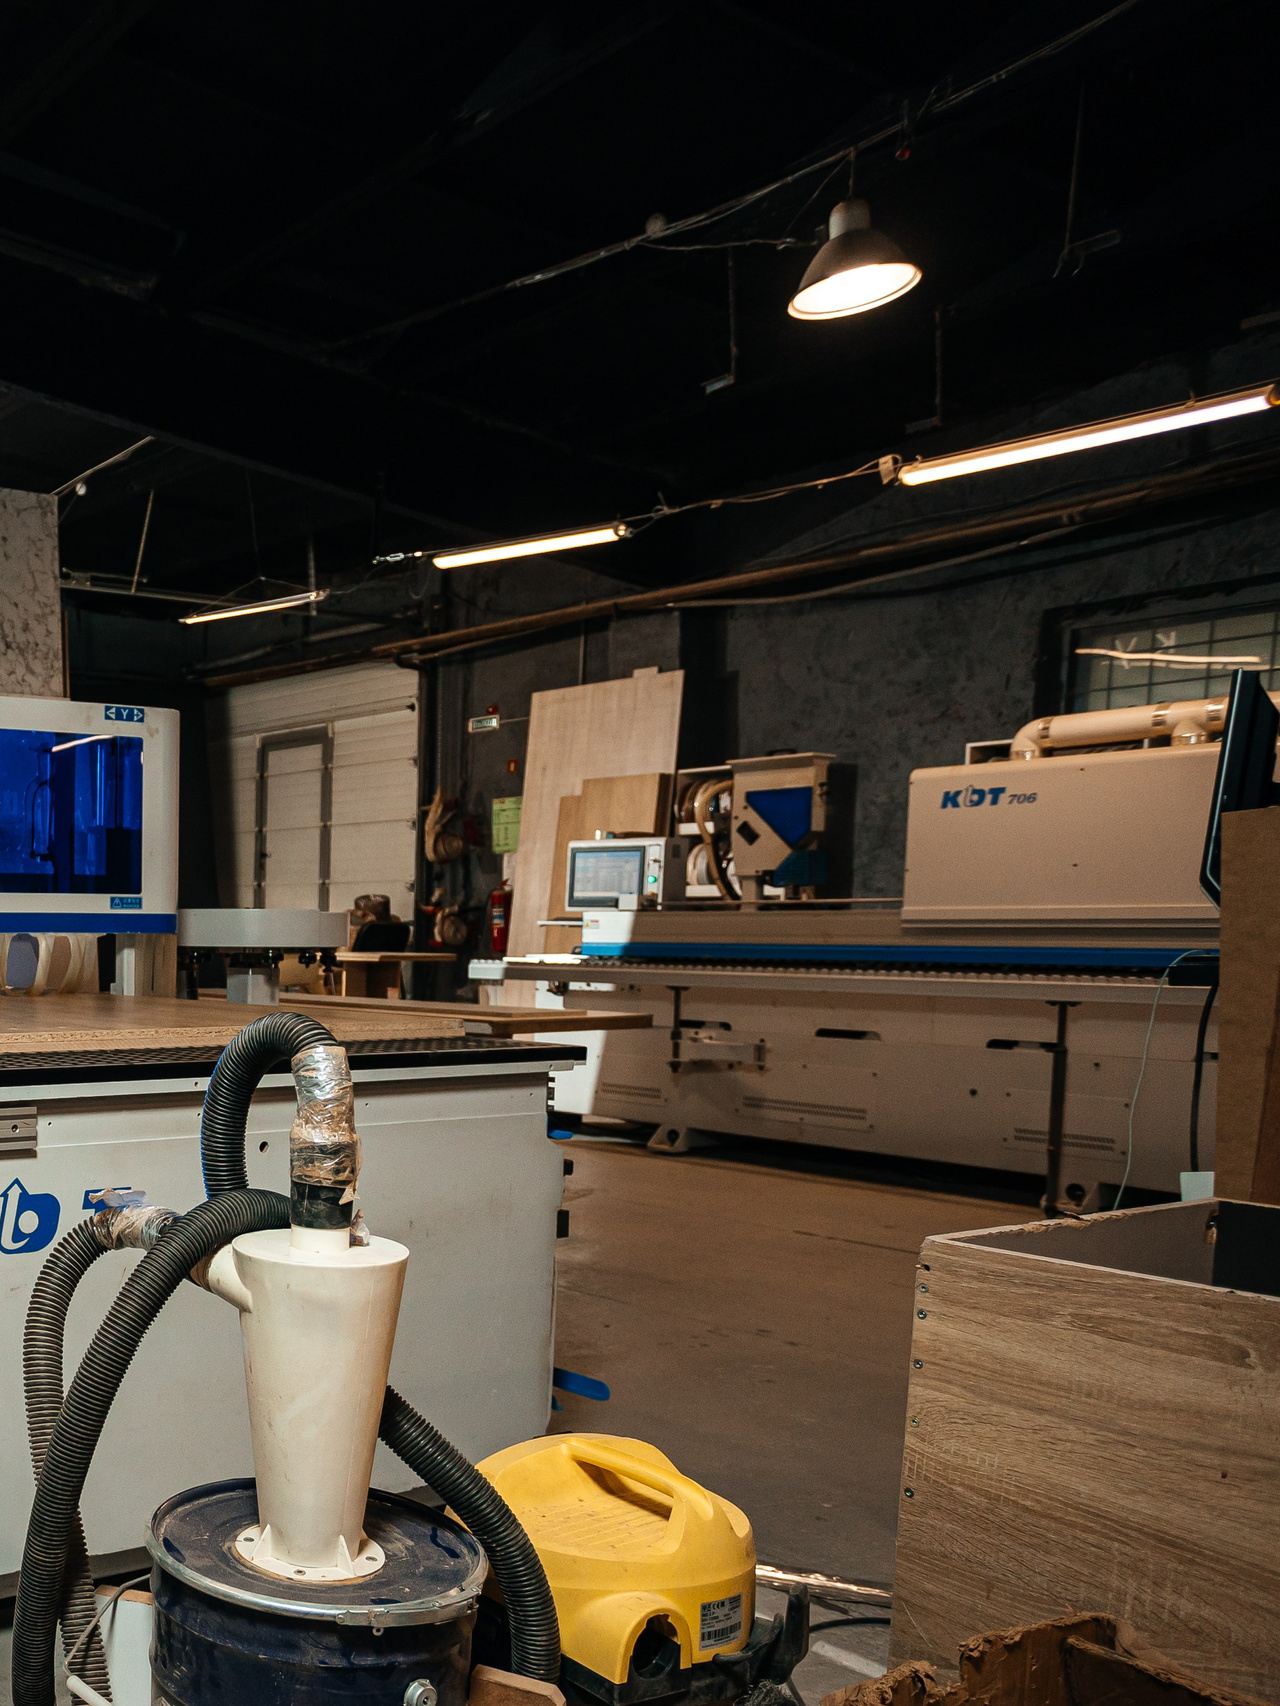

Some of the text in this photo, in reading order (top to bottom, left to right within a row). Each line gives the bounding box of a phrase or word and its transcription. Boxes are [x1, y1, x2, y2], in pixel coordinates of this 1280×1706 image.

[120, 708, 129, 719] Y
[940, 784, 1037, 809] KDT 706
